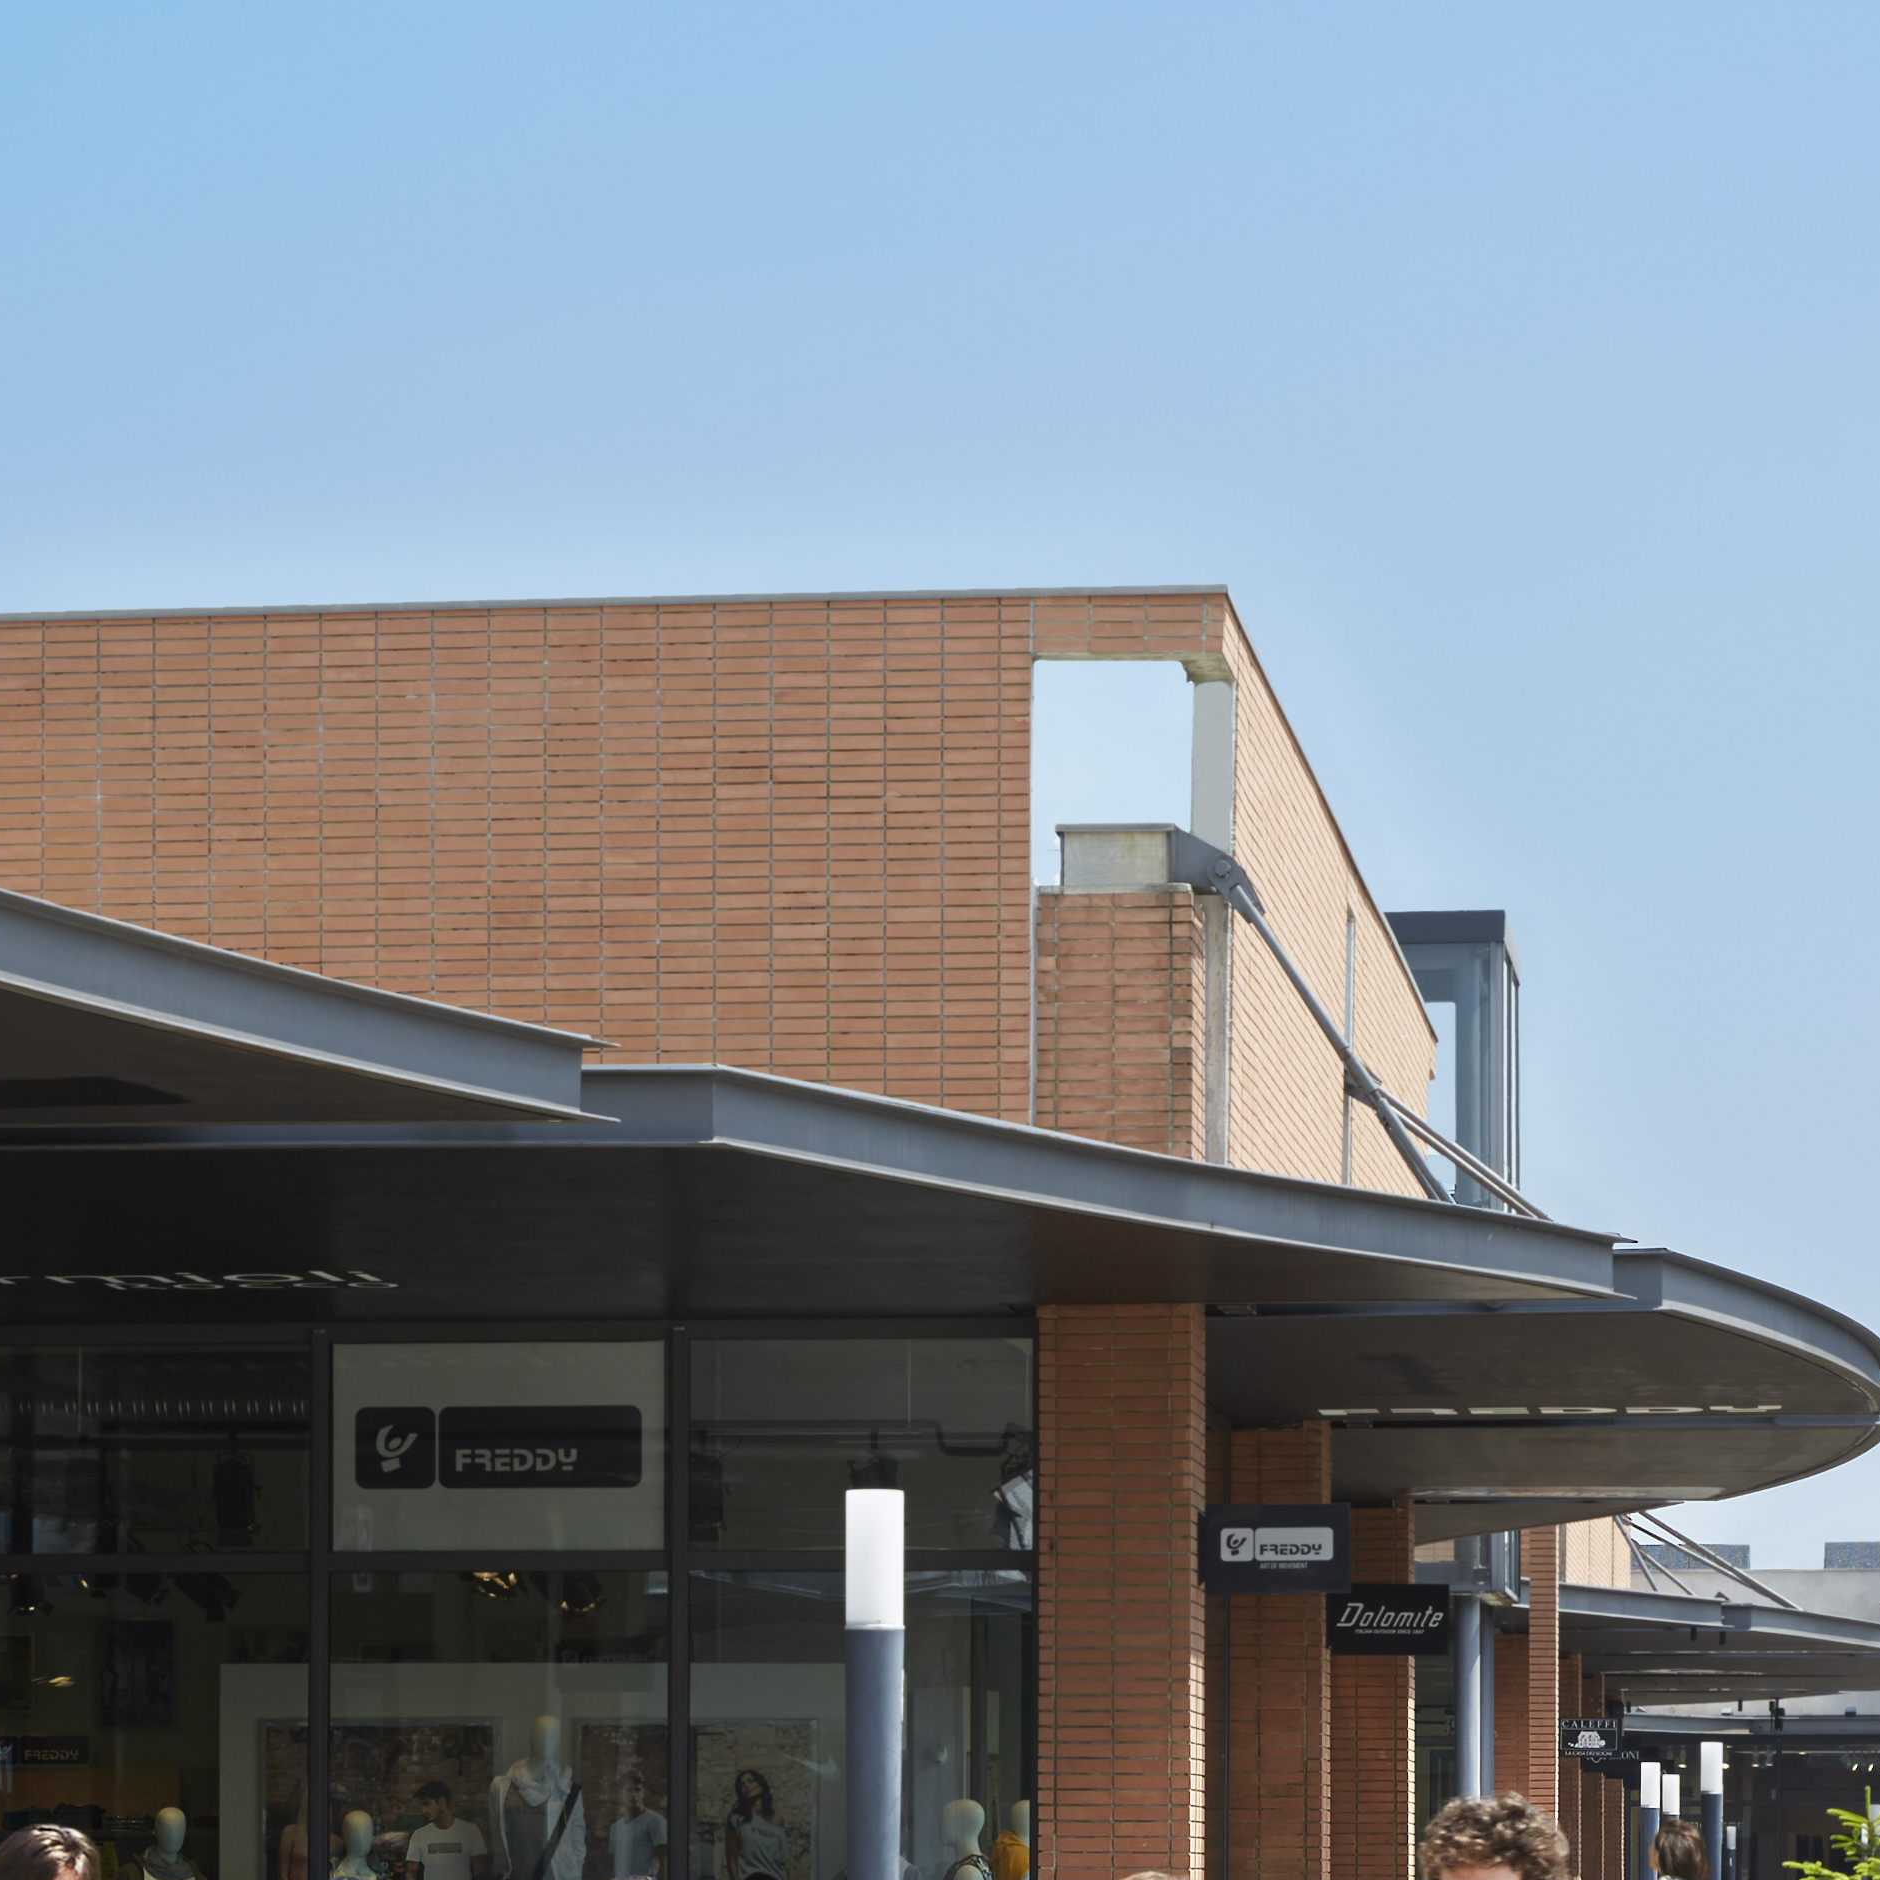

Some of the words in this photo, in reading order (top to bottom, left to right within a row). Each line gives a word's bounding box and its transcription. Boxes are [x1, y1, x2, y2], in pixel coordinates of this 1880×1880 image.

[104, 1281, 400, 1290] Rocco
[1317, 1405, 1784, 1416] FREDDY
[455, 1448, 578, 1472] FREDDY
[1259, 1543, 1323, 1556] FREDDY
[1336, 1602, 1444, 1628] Dolomite
[1561, 1720, 1617, 1728] CALEFFI
[23, 1749, 79, 1761] FREDDY
